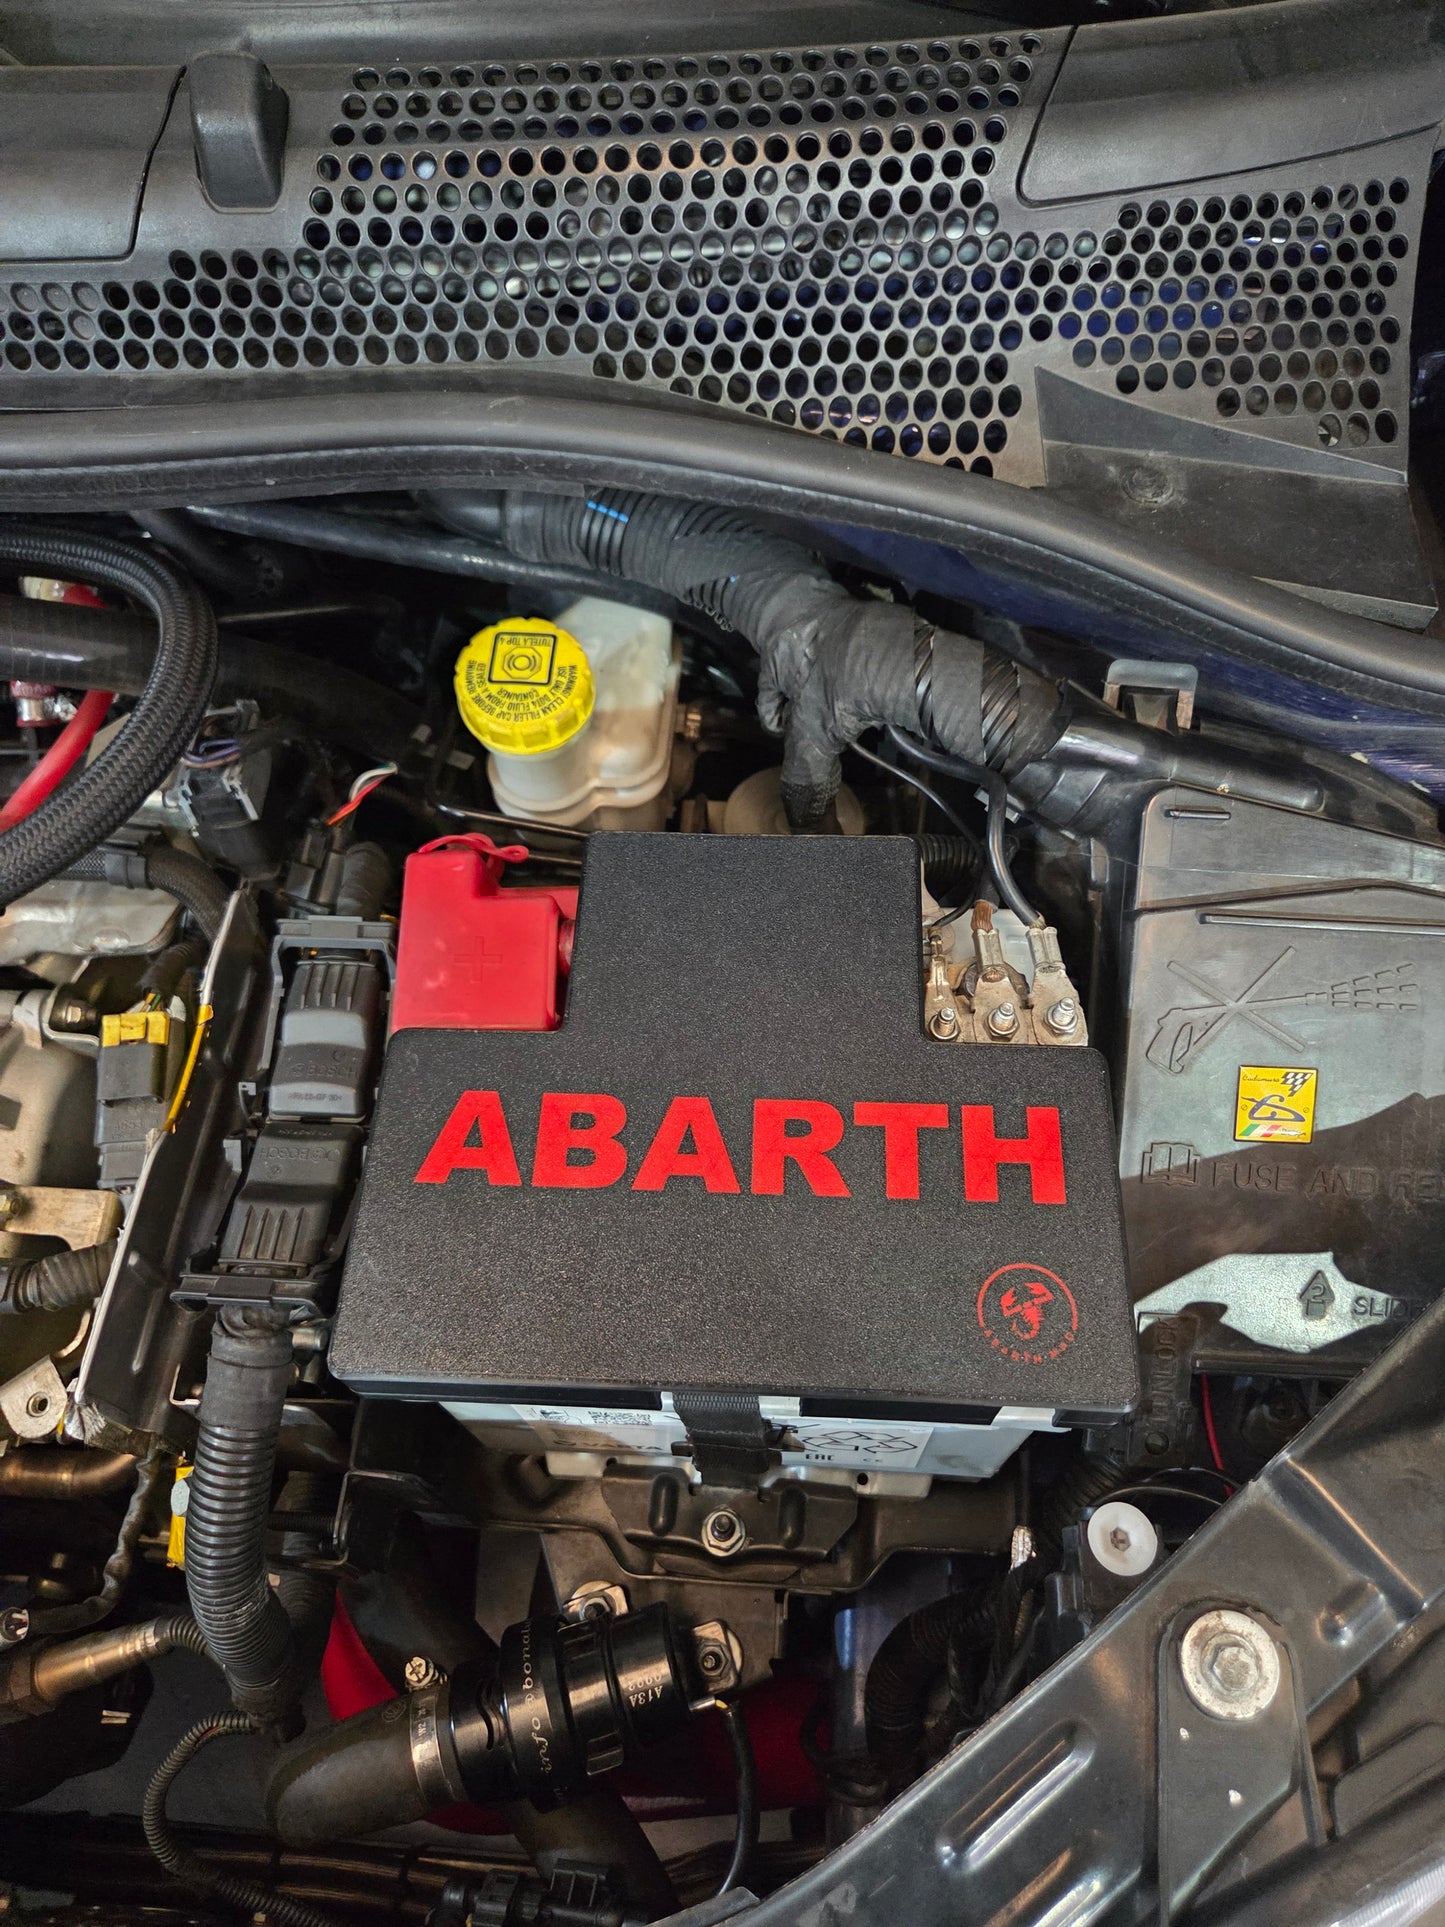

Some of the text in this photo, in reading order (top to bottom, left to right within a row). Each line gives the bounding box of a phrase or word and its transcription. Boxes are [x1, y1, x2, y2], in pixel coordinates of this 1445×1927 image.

[506, 638, 520, 646] TOP
[523, 638, 551, 647] TUTELA
[476, 662, 486, 689] SEALED
[558, 666, 567, 681] USE
[496, 687, 538, 702] CONTAINER
[548, 681, 562, 697] ONLY
[471, 694, 496, 716] BEFORE
[486, 691, 506, 708] FROM
[507, 702, 530, 712] FLUID
[541, 696, 563, 715] CLEAN
[496, 711, 512, 722] CAP
[514, 710, 540, 722] FILLER
[413, 1090, 1067, 1205] ABARTH
[1211, 1160, 1297, 1194] FUSE
[1306, 1166, 1379, 1199] AND
[628, 1685, 664, 1708] A13A
